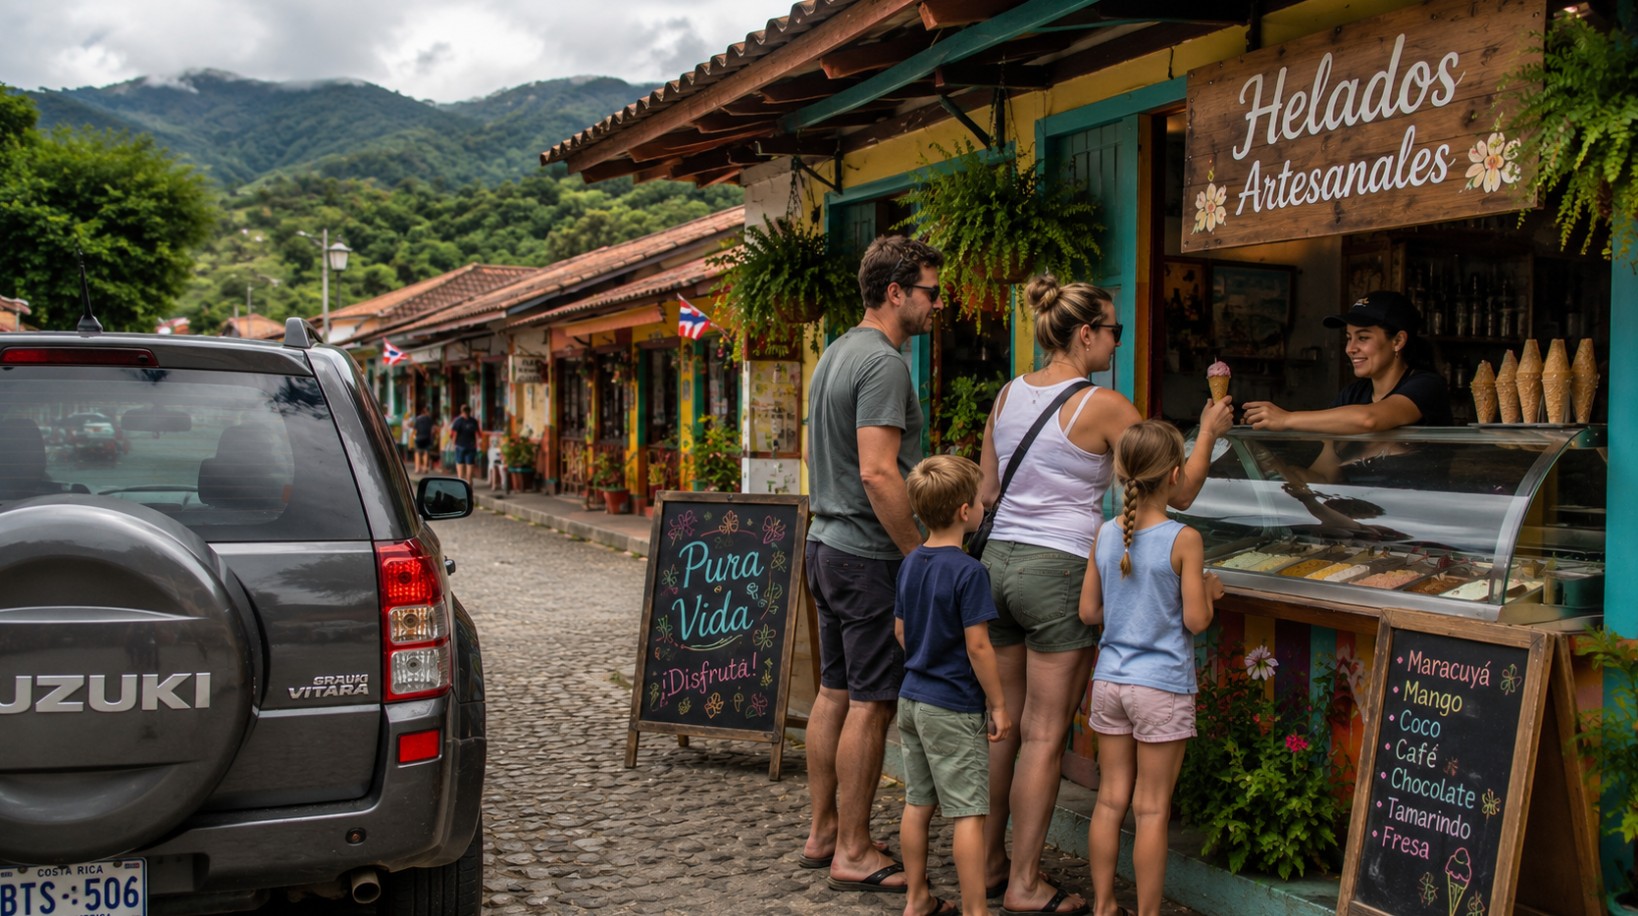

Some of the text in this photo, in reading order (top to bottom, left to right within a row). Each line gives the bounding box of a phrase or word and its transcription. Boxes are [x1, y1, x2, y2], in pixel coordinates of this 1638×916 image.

[1232, 33, 1465, 160] Helados
[1236, 125, 1455, 216] Artesanales
[678, 540, 764, 588] Pura
[671, 590, 753, 641] Vida
[1407, 650, 1491, 689] Maracuyá
[288, 683, 369, 699] VITARA
[1403, 680, 1463, 716] Mango
[1400, 709, 1441, 738] Coco
[1395, 738, 1438, 768] Café
[1391, 767, 1476, 809] Chocolate
[1388, 797, 1471, 840] Tamarindo
[1381, 826, 1430, 860] Fresa
[37, 865, 104, 877] COSTA RICA
